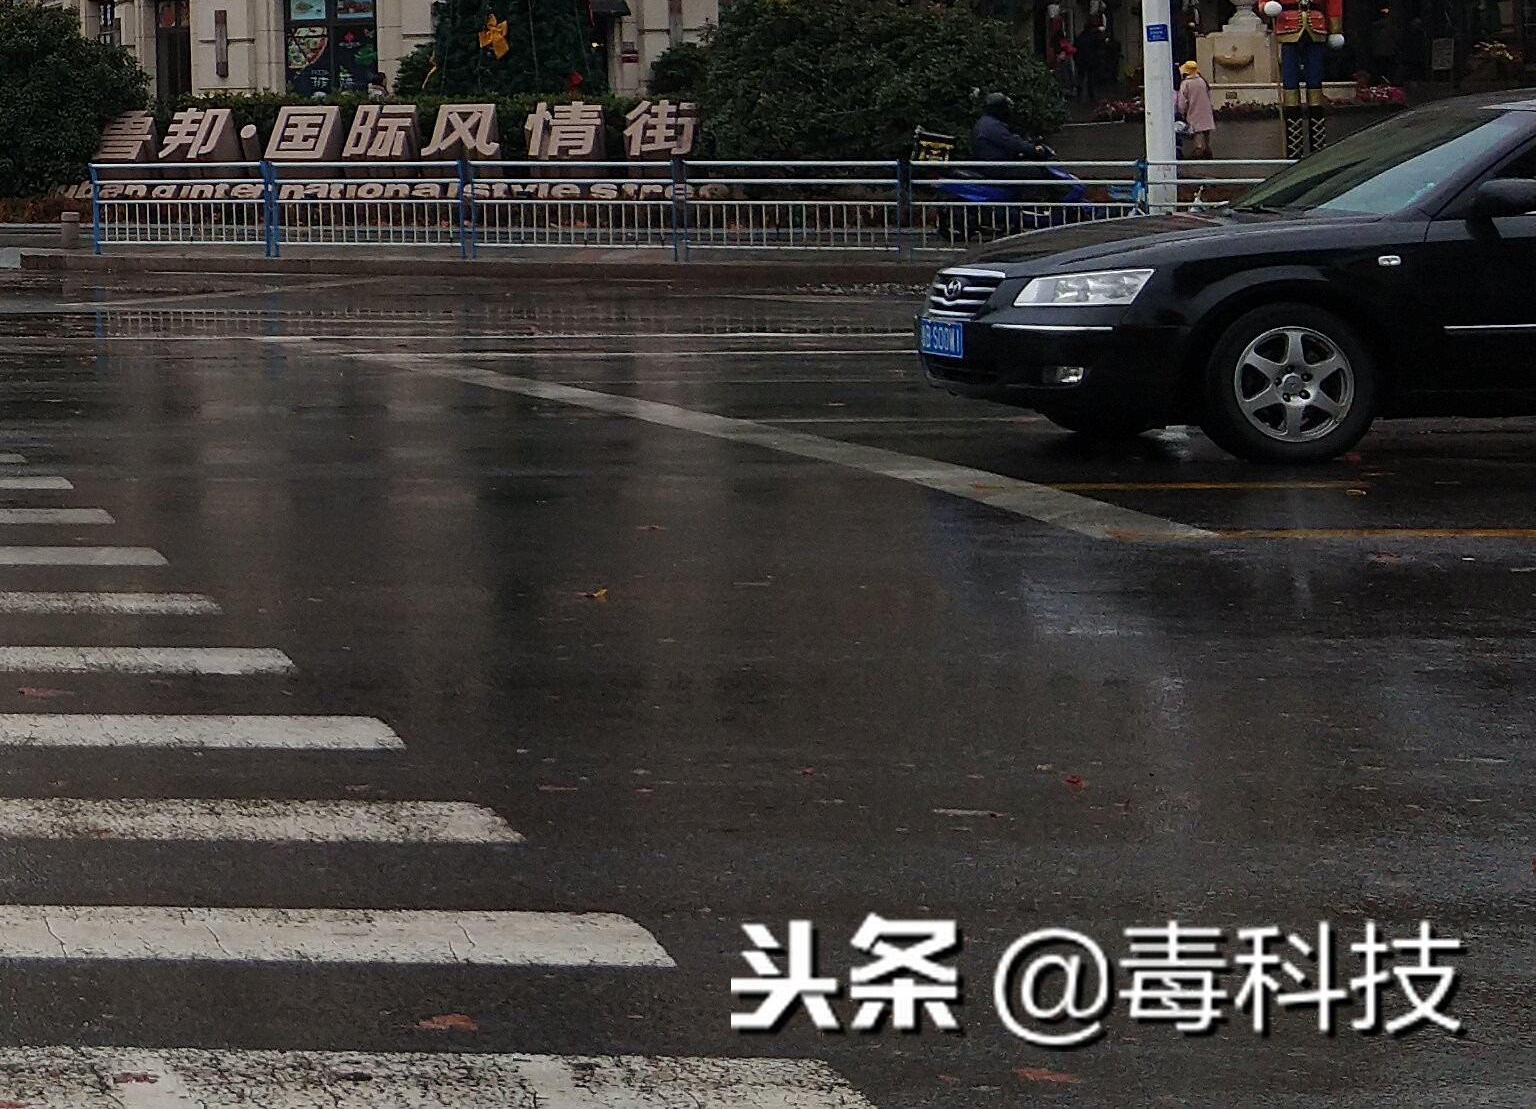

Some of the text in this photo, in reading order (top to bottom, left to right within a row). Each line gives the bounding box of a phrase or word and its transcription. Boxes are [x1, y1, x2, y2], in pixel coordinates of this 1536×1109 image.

[92, 100, 698, 158] 鲁邦·国际风情街
